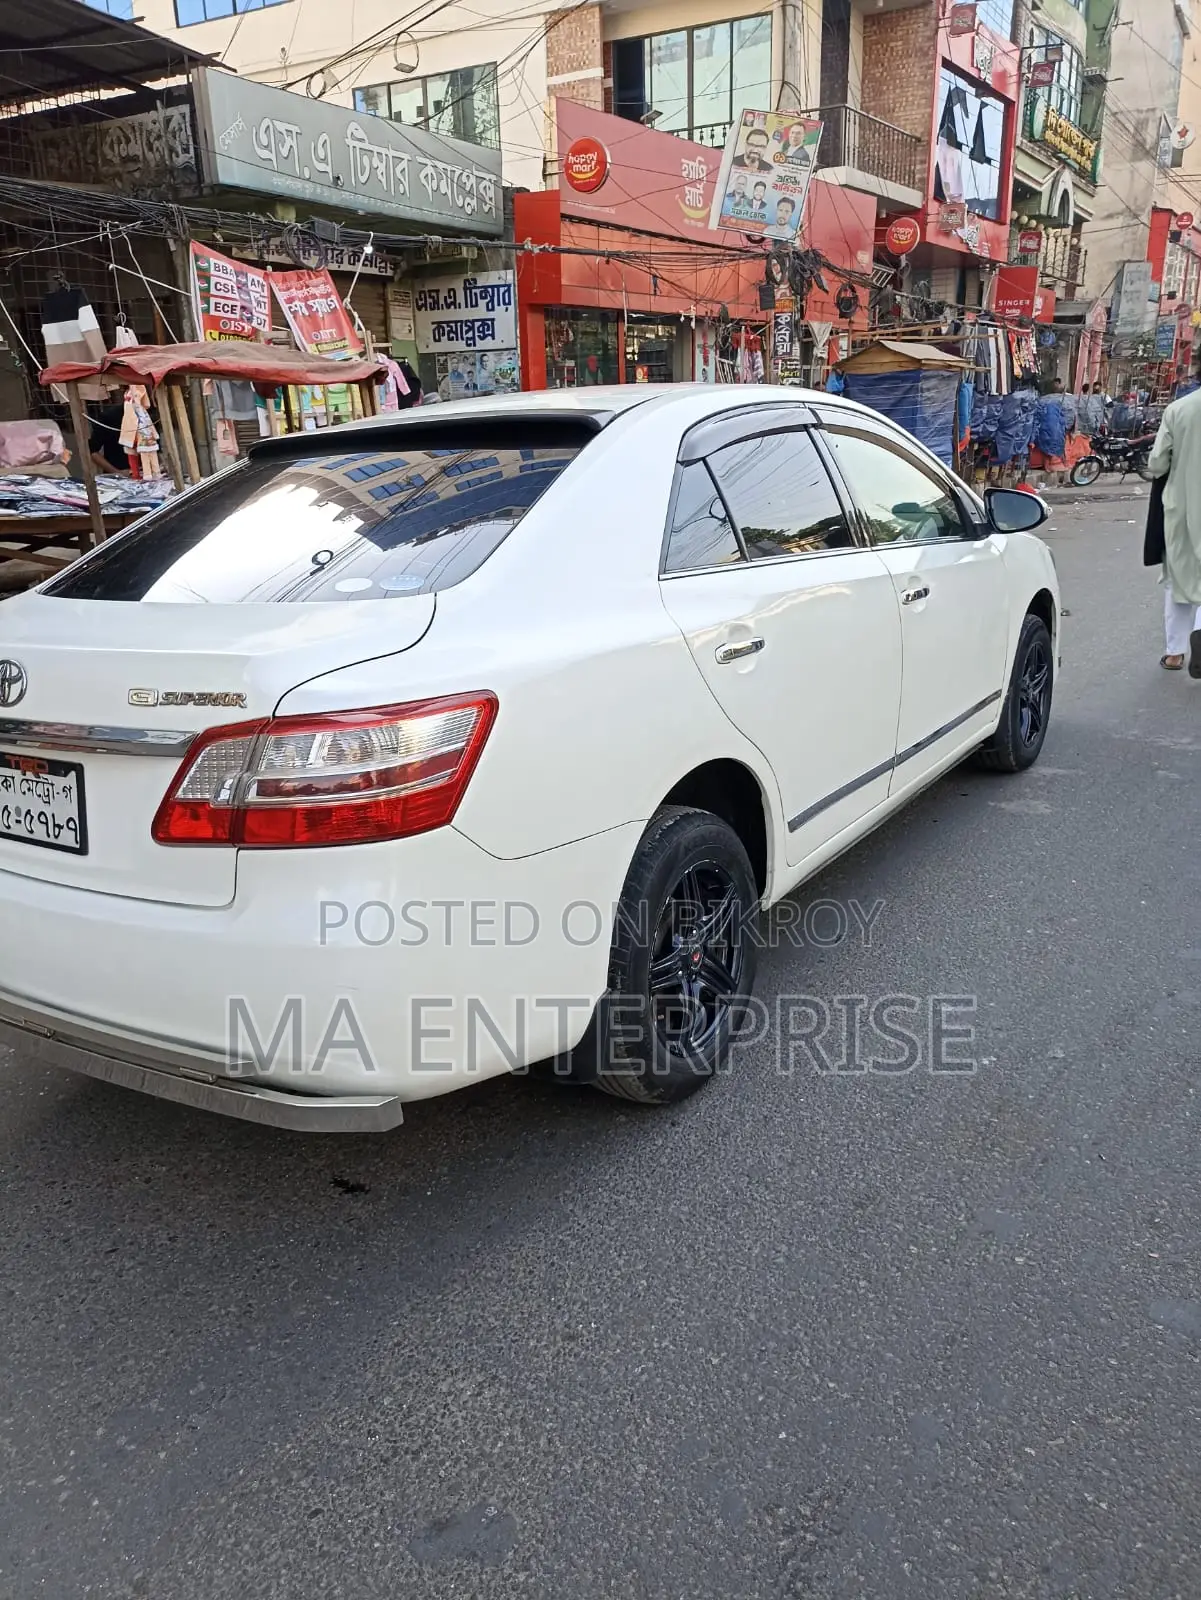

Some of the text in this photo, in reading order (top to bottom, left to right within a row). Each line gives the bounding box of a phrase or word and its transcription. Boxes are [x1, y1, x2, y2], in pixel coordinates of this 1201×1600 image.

[568, 152, 598, 165] happy
[572, 161, 597, 172] mart
[344, 121, 412, 198] টিম্বার
[415, 155, 497, 219] কমপ্লেক্স
[681, 156, 707, 183] হ্যাপি
[684, 182, 704, 208] মার্ট
[213, 262, 235, 277] BBA
[214, 281, 237, 295] CSE
[214, 301, 238, 315] ECE
[431, 318, 496, 348] কমপ্লেক্স
[159, 691, 247, 709] SUPERIOR
[5, 754, 48, 776] TRD
